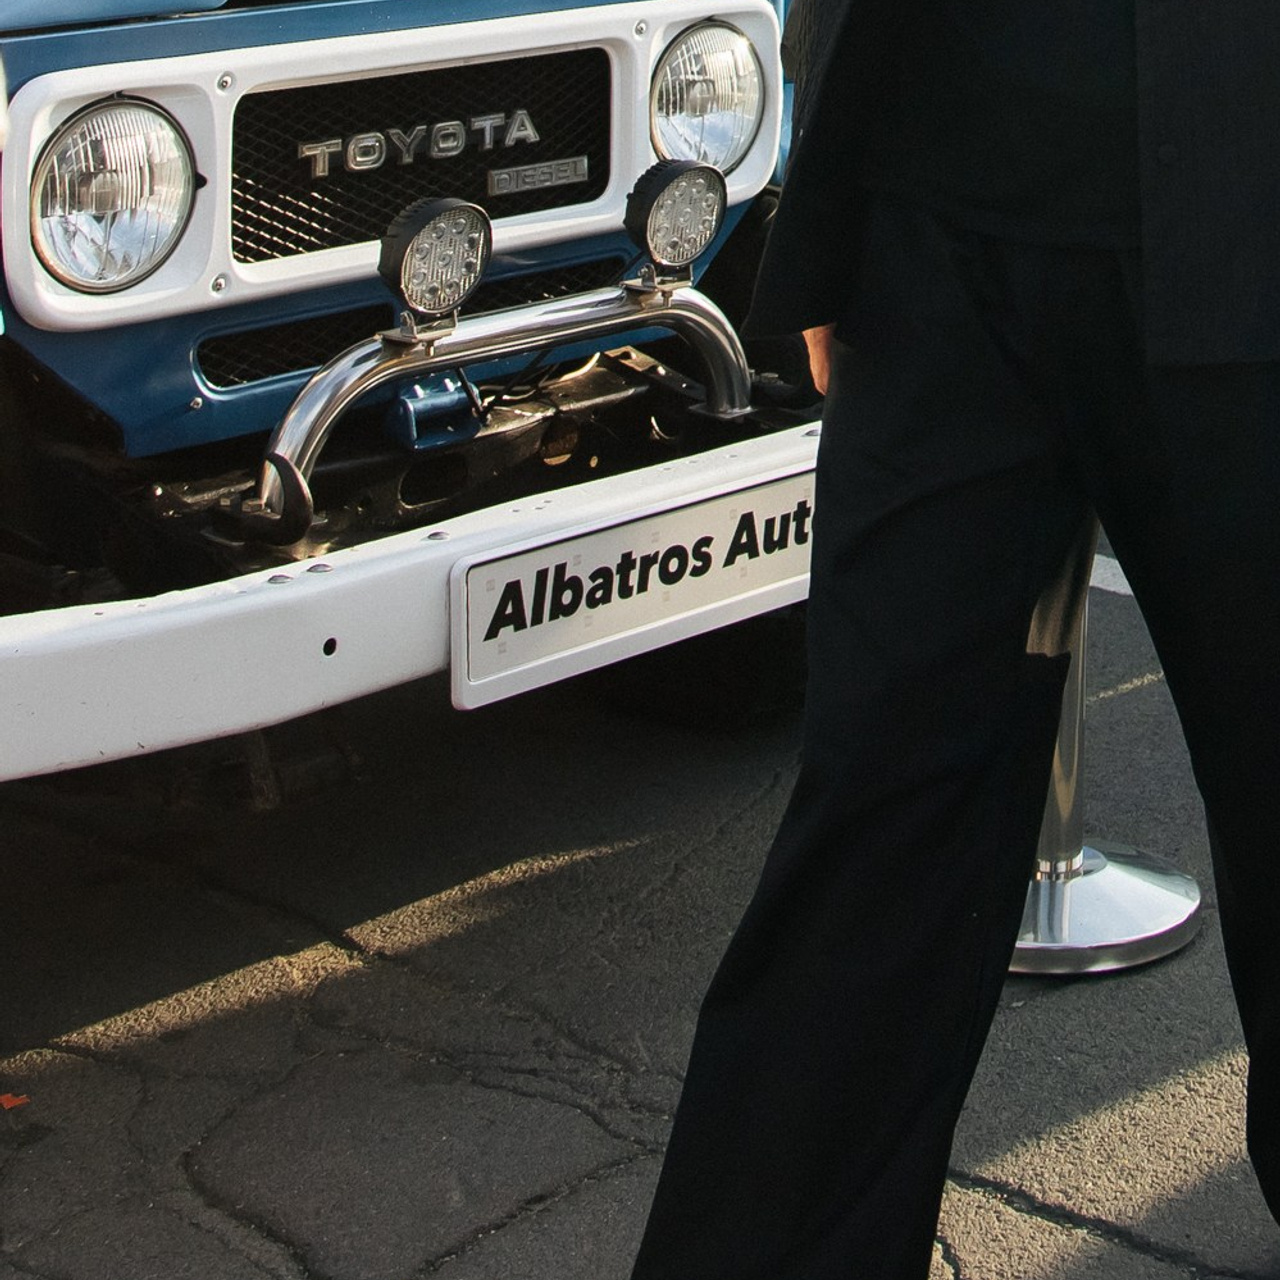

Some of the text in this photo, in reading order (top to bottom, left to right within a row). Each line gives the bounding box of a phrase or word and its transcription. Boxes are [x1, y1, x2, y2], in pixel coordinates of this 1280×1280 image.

[298, 109, 541, 180] TOYOTA
[493, 157, 586, 193] DIESEL
[483, 499, 812, 642] Albatros Aut
